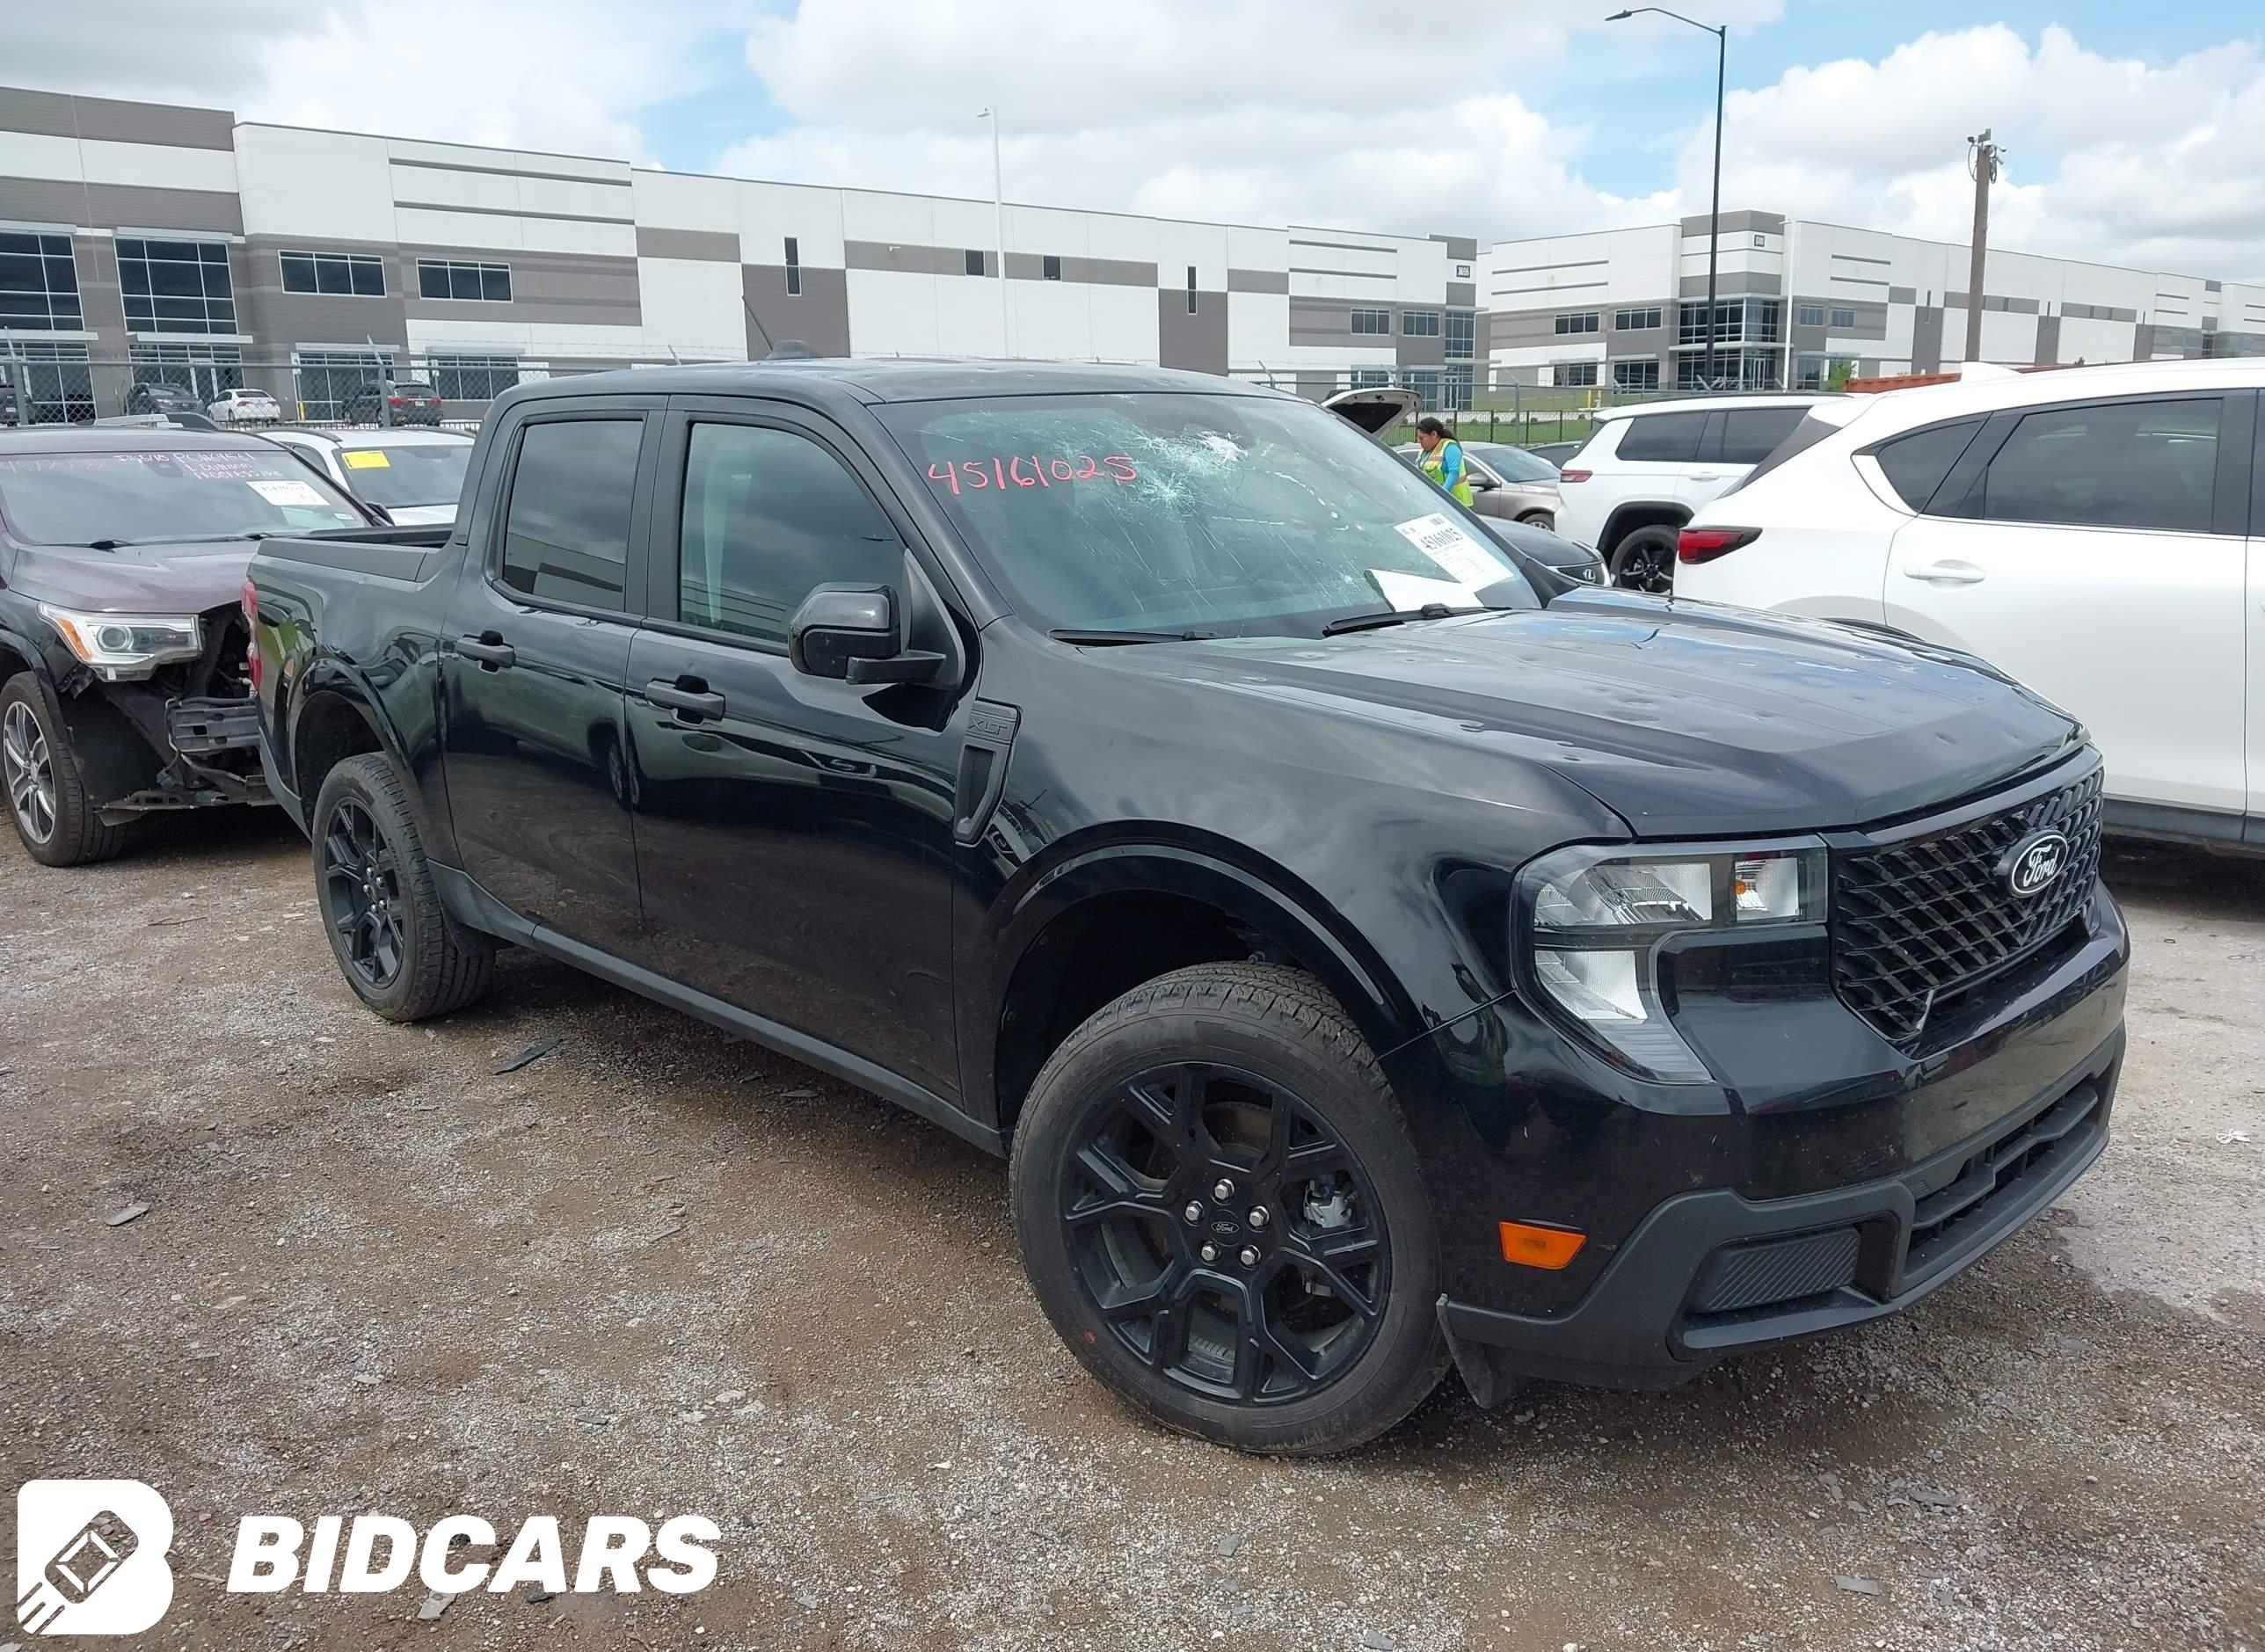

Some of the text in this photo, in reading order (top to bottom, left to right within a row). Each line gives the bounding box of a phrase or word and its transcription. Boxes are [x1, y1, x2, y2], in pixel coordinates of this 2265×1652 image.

[928, 455, 1138, 495] 45161025
[968, 718, 1008, 735] XLT
[2021, 841, 2061, 889] Ford
[1214, 1222, 1234, 1233] Ford
